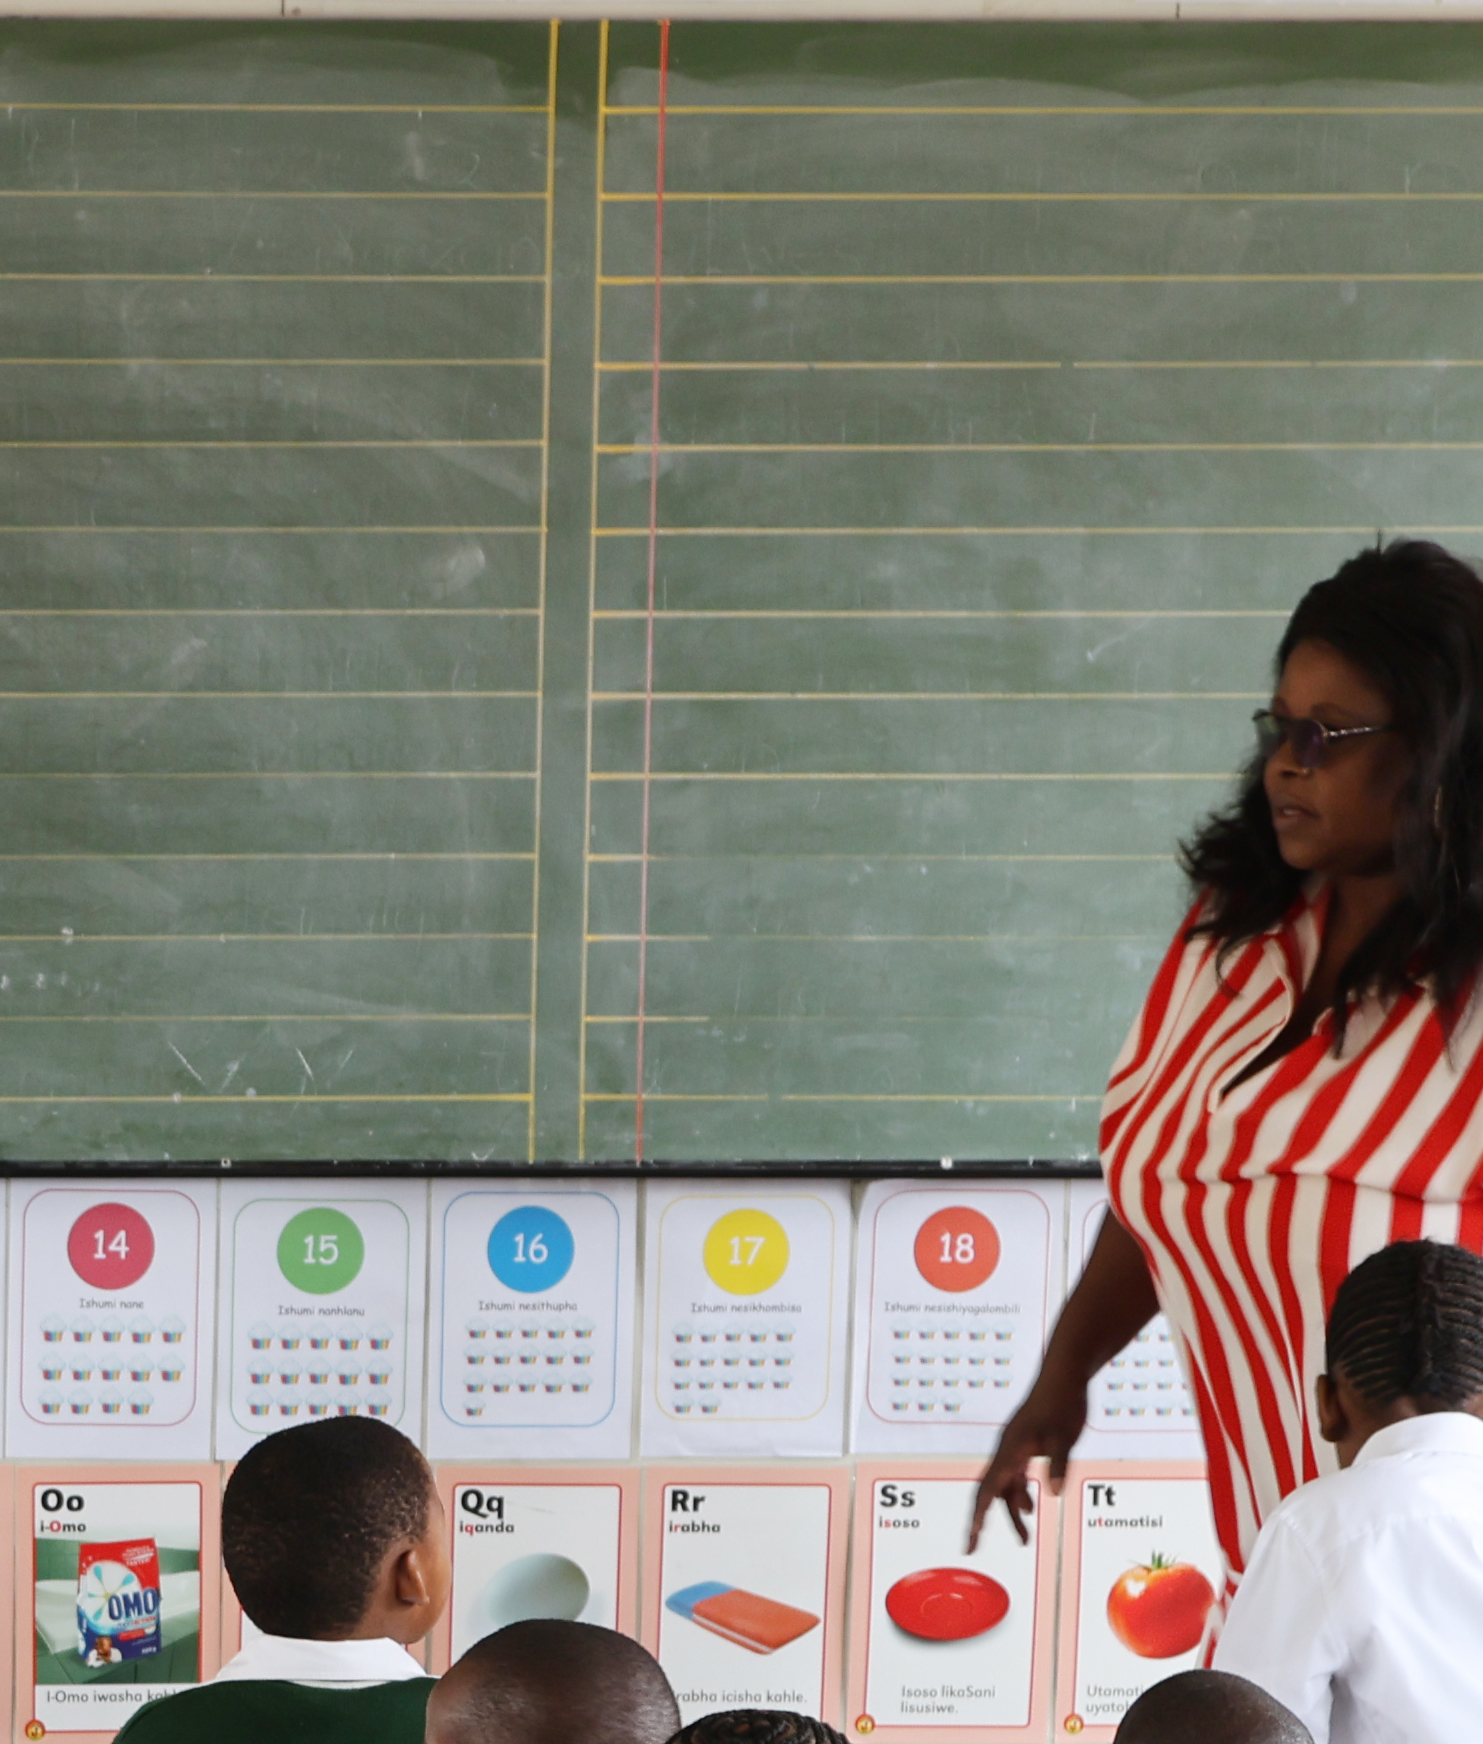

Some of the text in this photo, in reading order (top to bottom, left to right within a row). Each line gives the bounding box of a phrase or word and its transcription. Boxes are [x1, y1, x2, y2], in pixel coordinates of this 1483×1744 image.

[93, 1230, 129, 1260] 14
[303, 1234, 339, 1265] 15
[512, 1234, 548, 1264] 16
[728, 1237, 765, 1266] 17
[938, 1232, 976, 1262] 18
[79, 1298, 144, 1309] Ishumi nane
[479, 1300, 577, 1314] Ishumi nesithupha
[691, 1302, 727, 1314] Ishumi
[884, 1301, 921, 1312] Ishumi
[278, 1305, 365, 1317] Ishumi nanhlanu
[40, 1489, 85, 1512] Oo
[671, 1490, 705, 1512] Rr
[879, 1484, 916, 1508] Ss
[1088, 1485, 1115, 1507] Tt
[461, 1489, 505, 1518] Qq
[40, 1519, 86, 1533] i-Omo
[459, 1520, 515, 1536] iqanda
[669, 1519, 721, 1533] irabha
[879, 1516, 920, 1529] isoso
[1087, 1515, 1163, 1528] utamatisi
[108, 1587, 159, 1620] OMO
[93, 1690, 142, 1703] iwasha
[675, 1689, 807, 1703] rabha icisha kahle.
[902, 1684, 996, 1698] Isoso likaSani
[1086, 1685, 1144, 1699] Utamati
[900, 1701, 958, 1715] lisusiwe.
